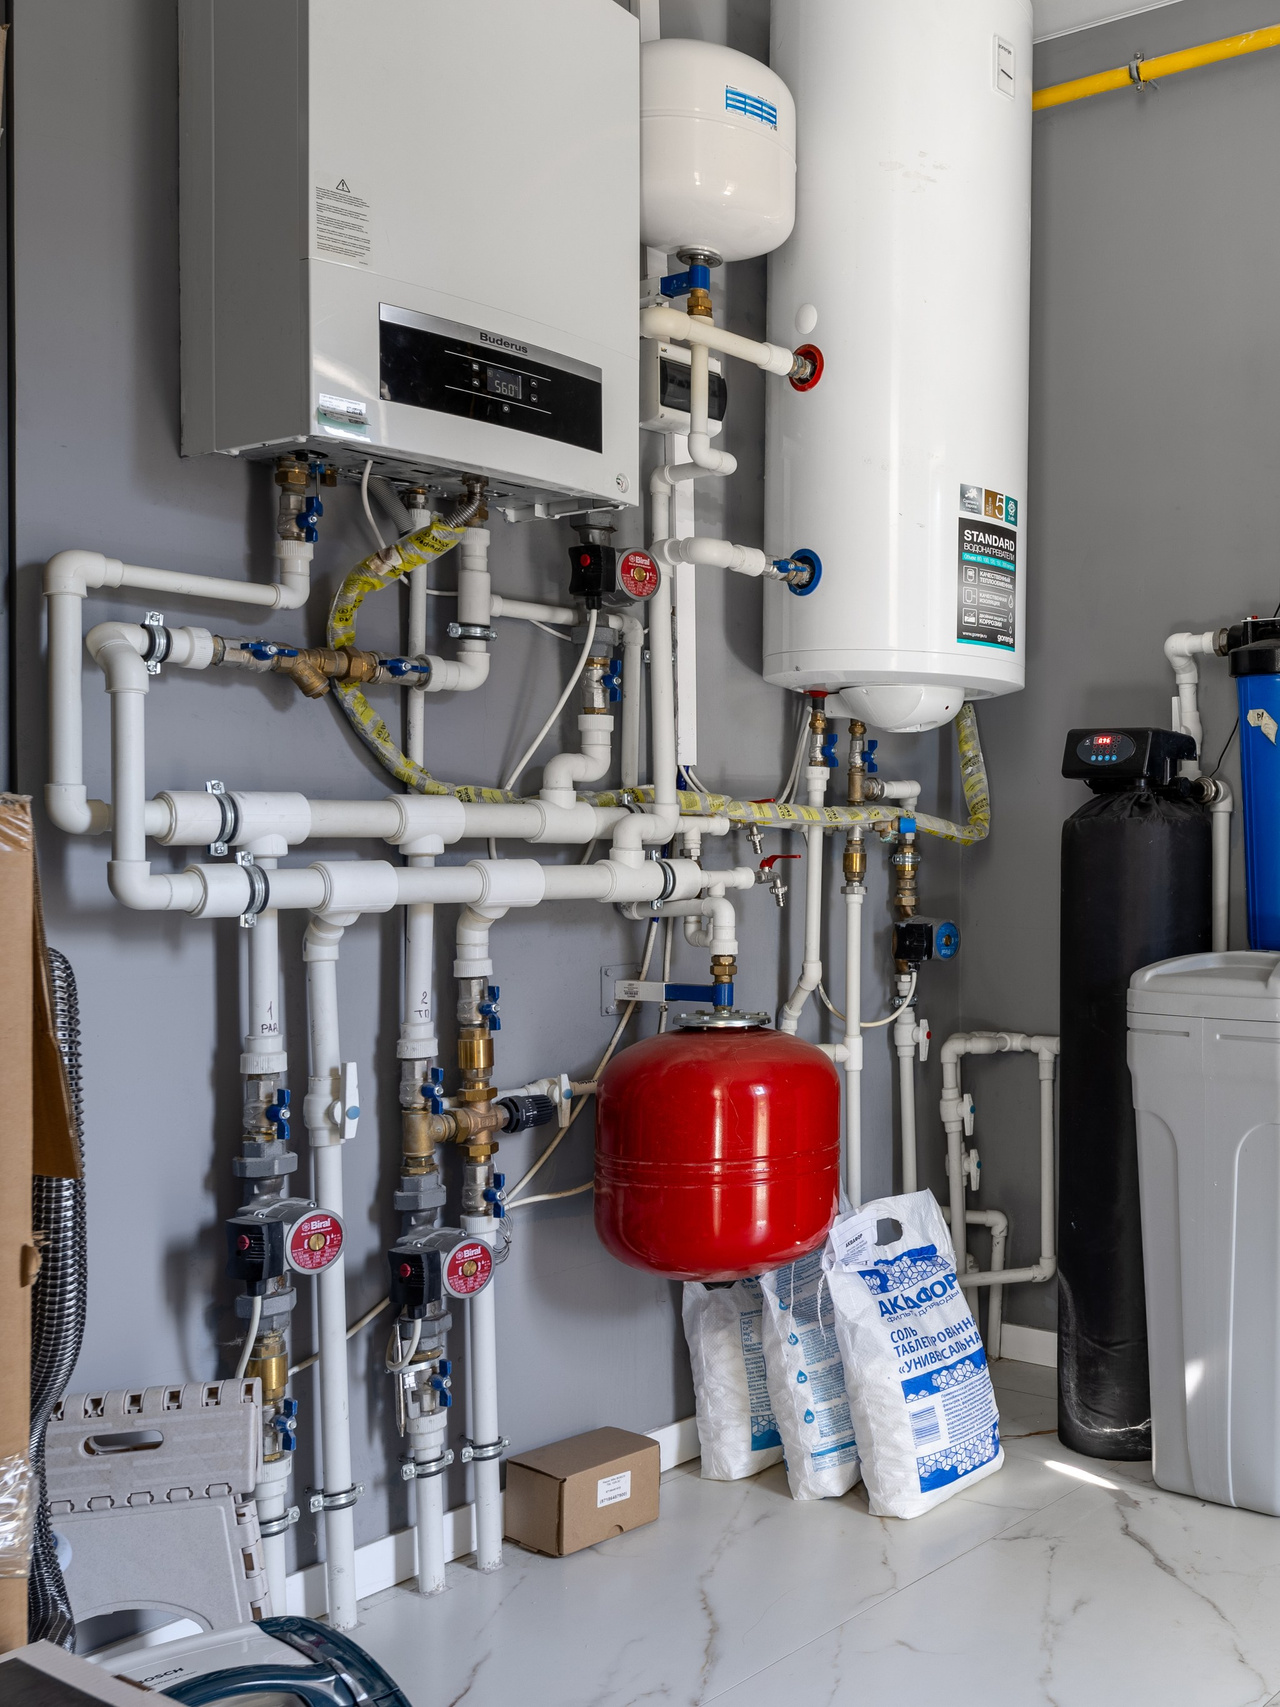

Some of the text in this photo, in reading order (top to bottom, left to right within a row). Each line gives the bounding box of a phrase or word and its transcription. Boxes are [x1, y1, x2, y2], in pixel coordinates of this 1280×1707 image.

[480, 331, 528, 354] Buderus
[995, 494, 1004, 518] 5
[964, 529, 1015, 552] STANDARD
[636, 555, 650, 566] Biral
[964, 542, 1015, 561] ВОДОНАГРЕВАТЕЛИ
[980, 619, 1002, 627] КОРРОЗИИ
[997, 634, 1014, 644] gorenje
[421, 991, 428, 1005] 2
[267, 1000, 272, 1020] 1
[310, 1217, 332, 1230] Biral
[845, 1233, 863, 1248] АКВАФОР
[463, 1245, 482, 1258] Biral
[878, 1272, 957, 1317] АКАФОР
[890, 1326, 918, 1344] СОЛЬ
[893, 1314, 976, 1358] ТАБЛЕТРОВАННА
[898, 1331, 982, 1374] «УНИВЕСАЛЬНА
